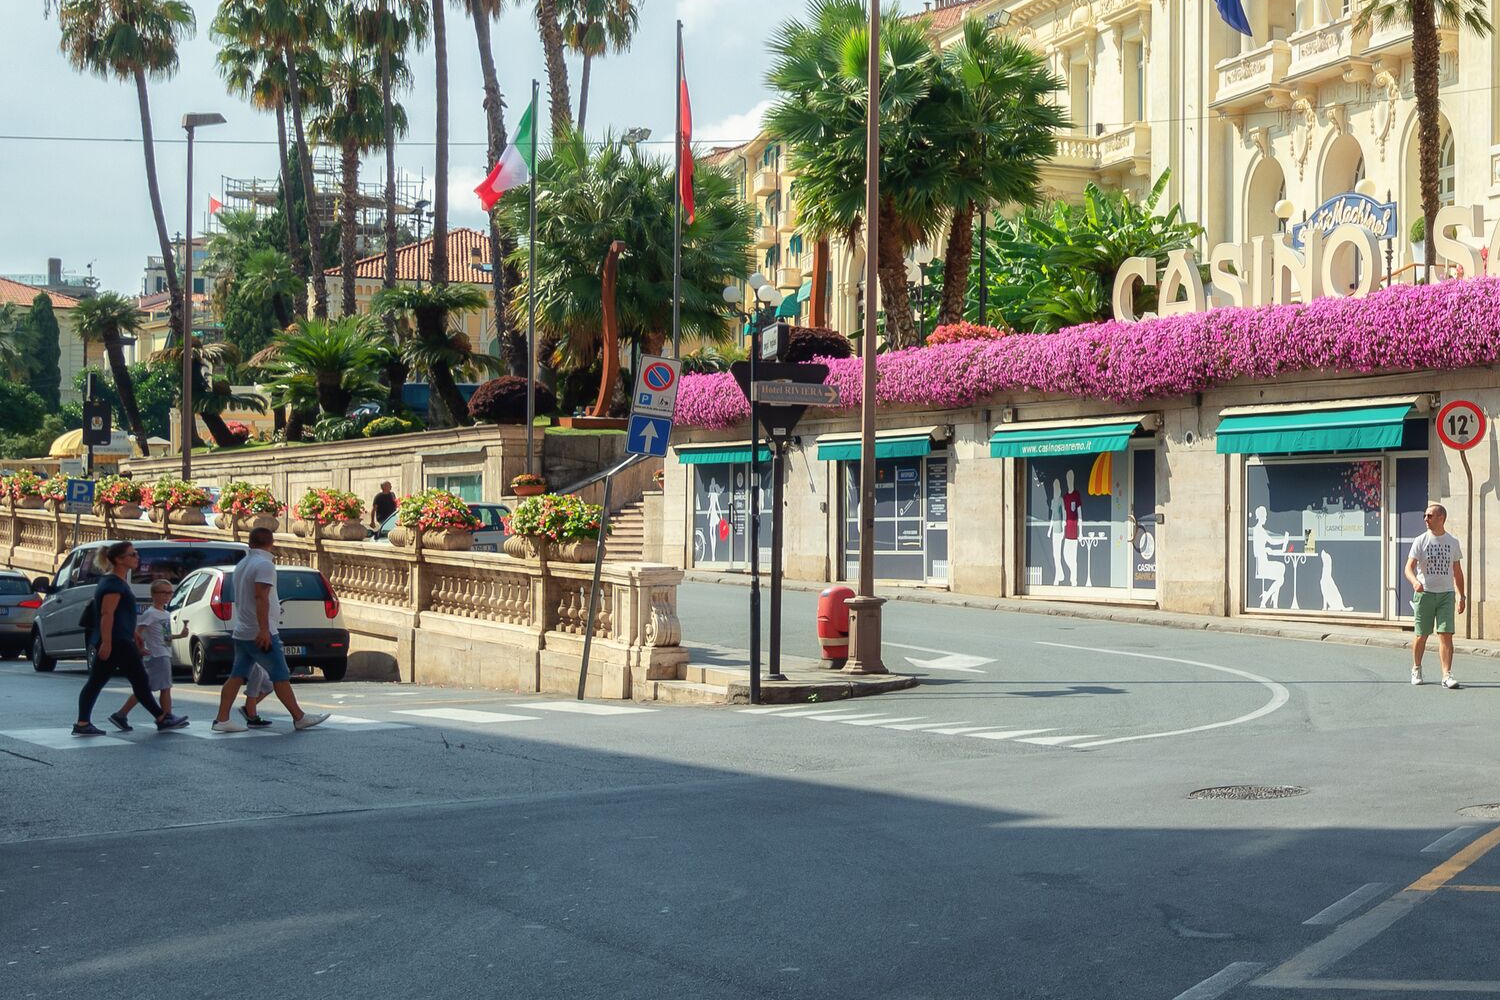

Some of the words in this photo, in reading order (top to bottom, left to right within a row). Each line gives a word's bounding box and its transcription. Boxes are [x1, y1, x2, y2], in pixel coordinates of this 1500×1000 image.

[1113, 224, 1382, 324] CASINO
[761, 385, 783, 394] Hotel
[784, 387, 823, 396] RIVIERA
[642, 395, 649, 404] P
[1448, 414, 1469, 436] 12
[1022, 440, 1092, 454] www.casinosanremo.it
[72, 483, 89, 500] P
